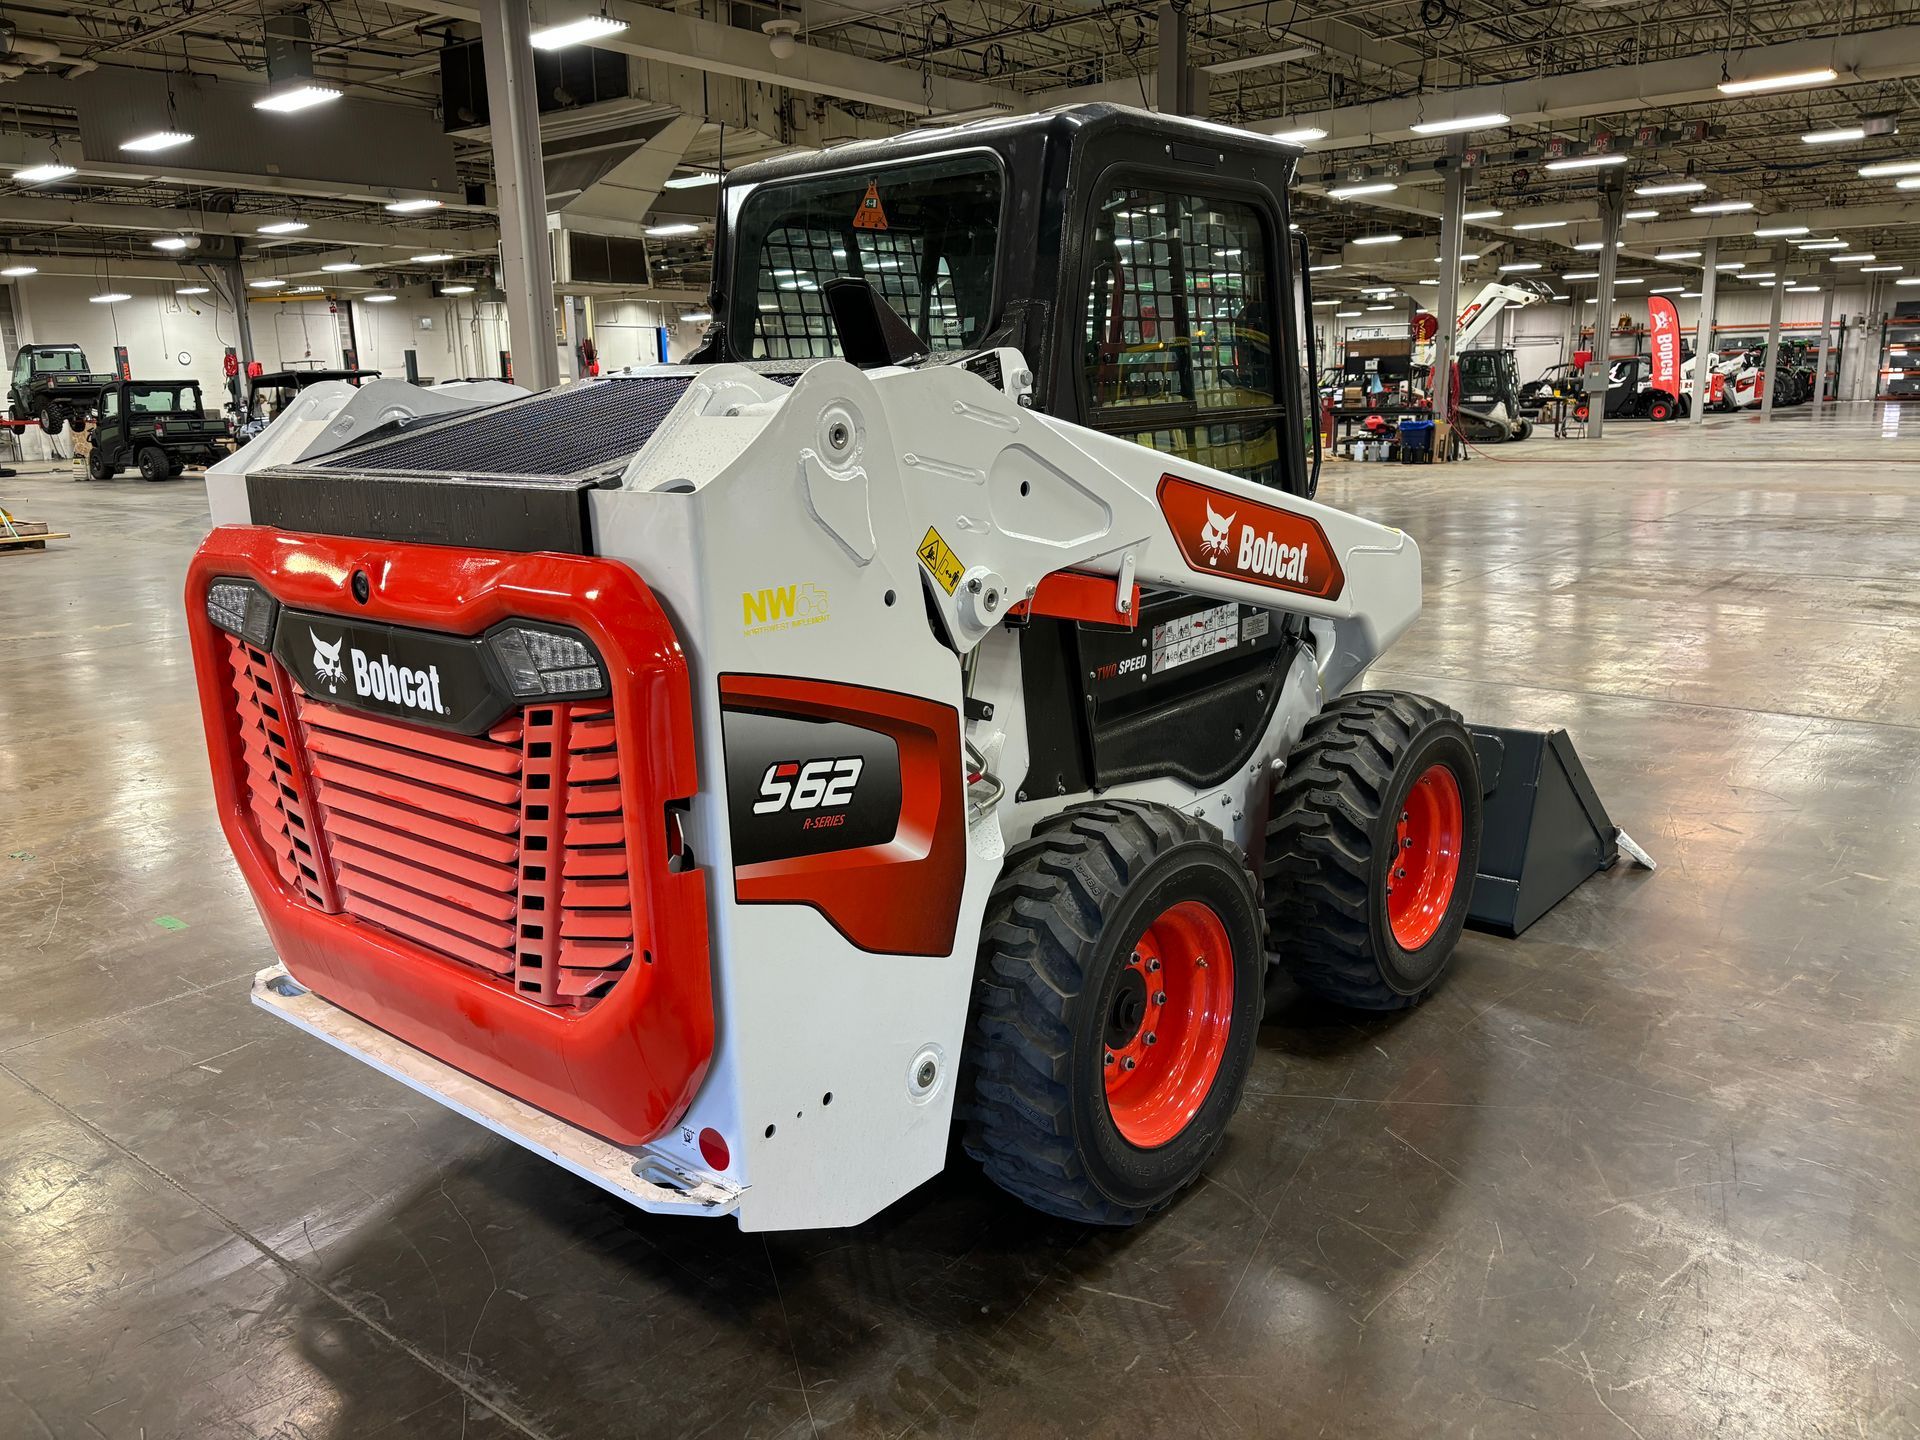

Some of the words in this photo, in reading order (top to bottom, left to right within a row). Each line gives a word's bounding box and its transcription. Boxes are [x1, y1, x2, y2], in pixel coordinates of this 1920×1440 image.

[1237, 524, 1308, 584] Bobcat
[742, 584, 797, 626] NW
[350, 648, 444, 715] Bobcat
[1096, 662, 1117, 681] TWO
[1118, 654, 1147, 676] SPEED
[753, 757, 863, 814] S62
[803, 814, 846, 830] R-SERIES
